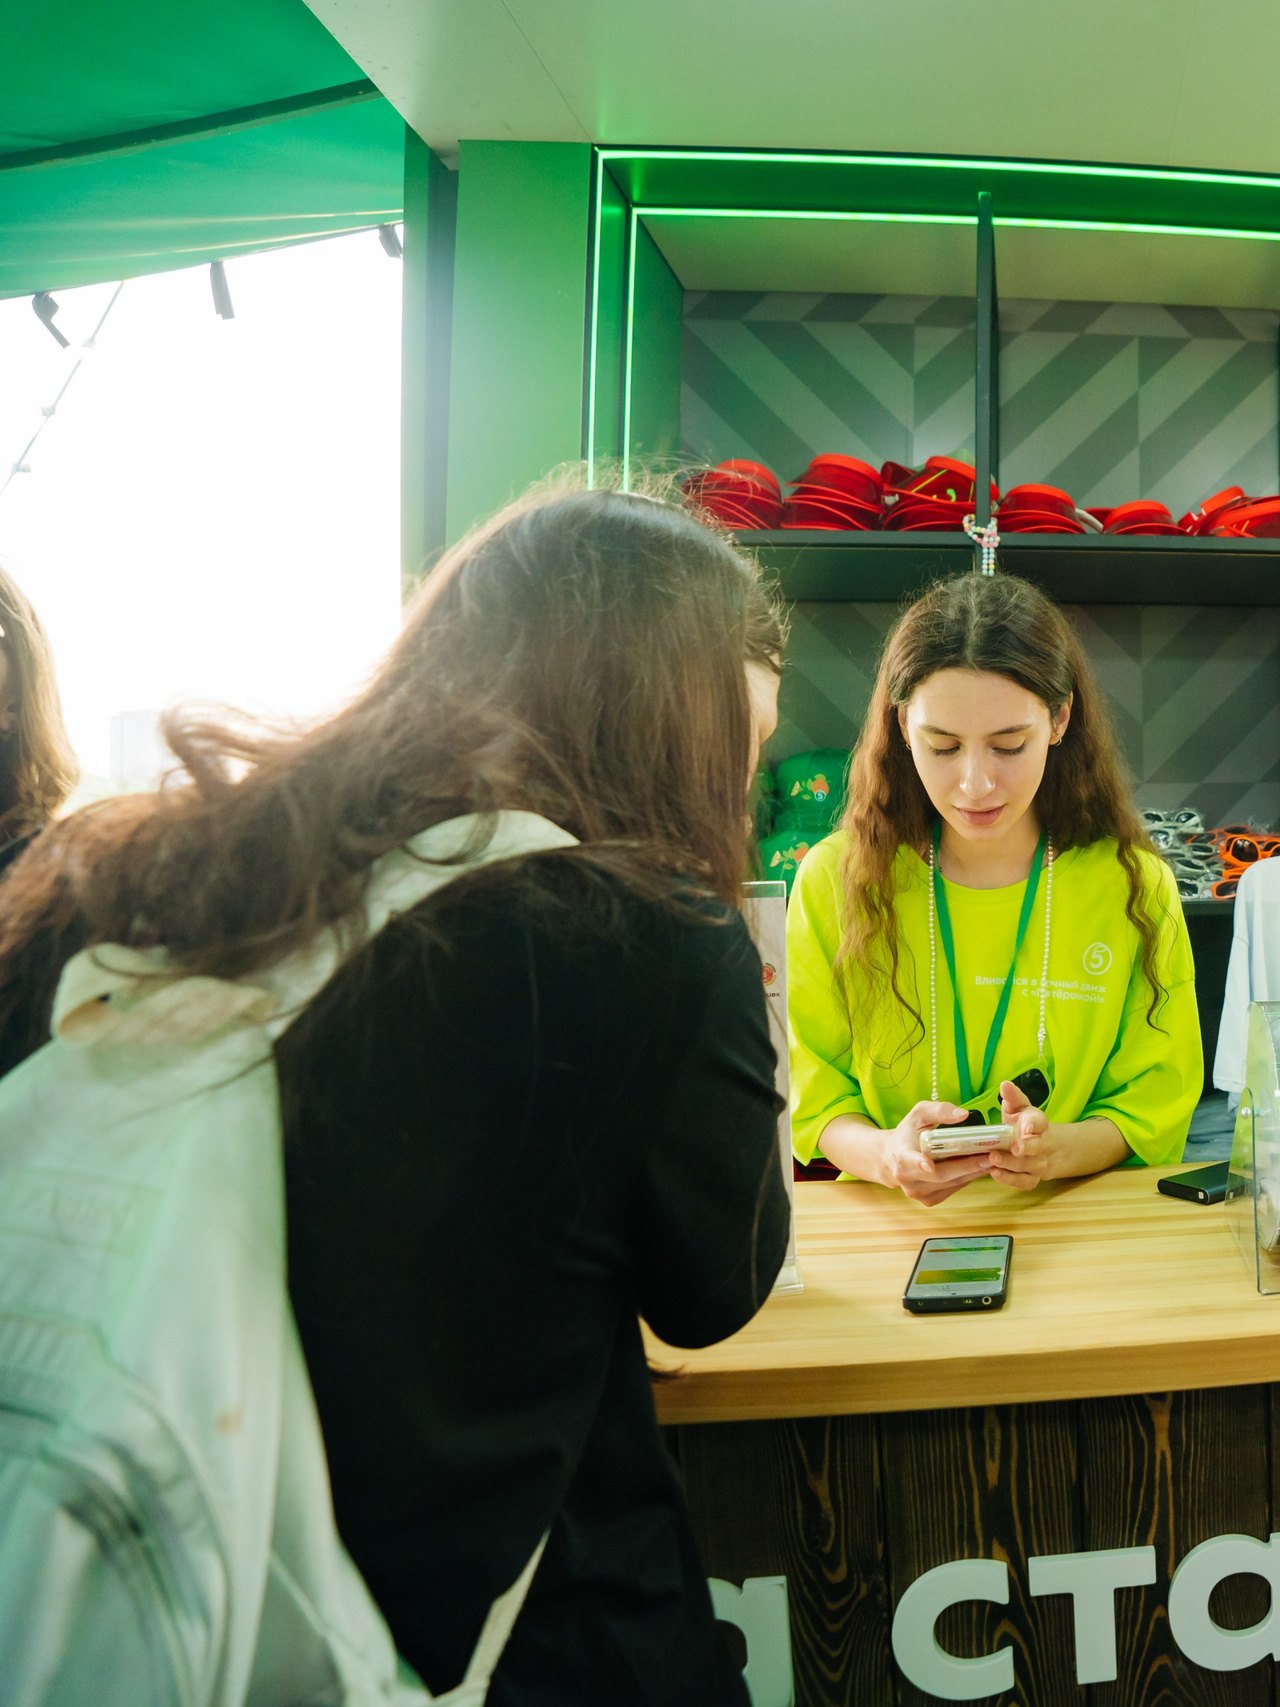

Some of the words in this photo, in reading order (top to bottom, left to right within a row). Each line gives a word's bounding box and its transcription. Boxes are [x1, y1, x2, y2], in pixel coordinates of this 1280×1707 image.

[1089, 945, 1108, 968] 5
[975, 975, 1028, 986] Вливася
[1030, 978, 1037, 986] в
[1080, 983, 1107, 994] движ
